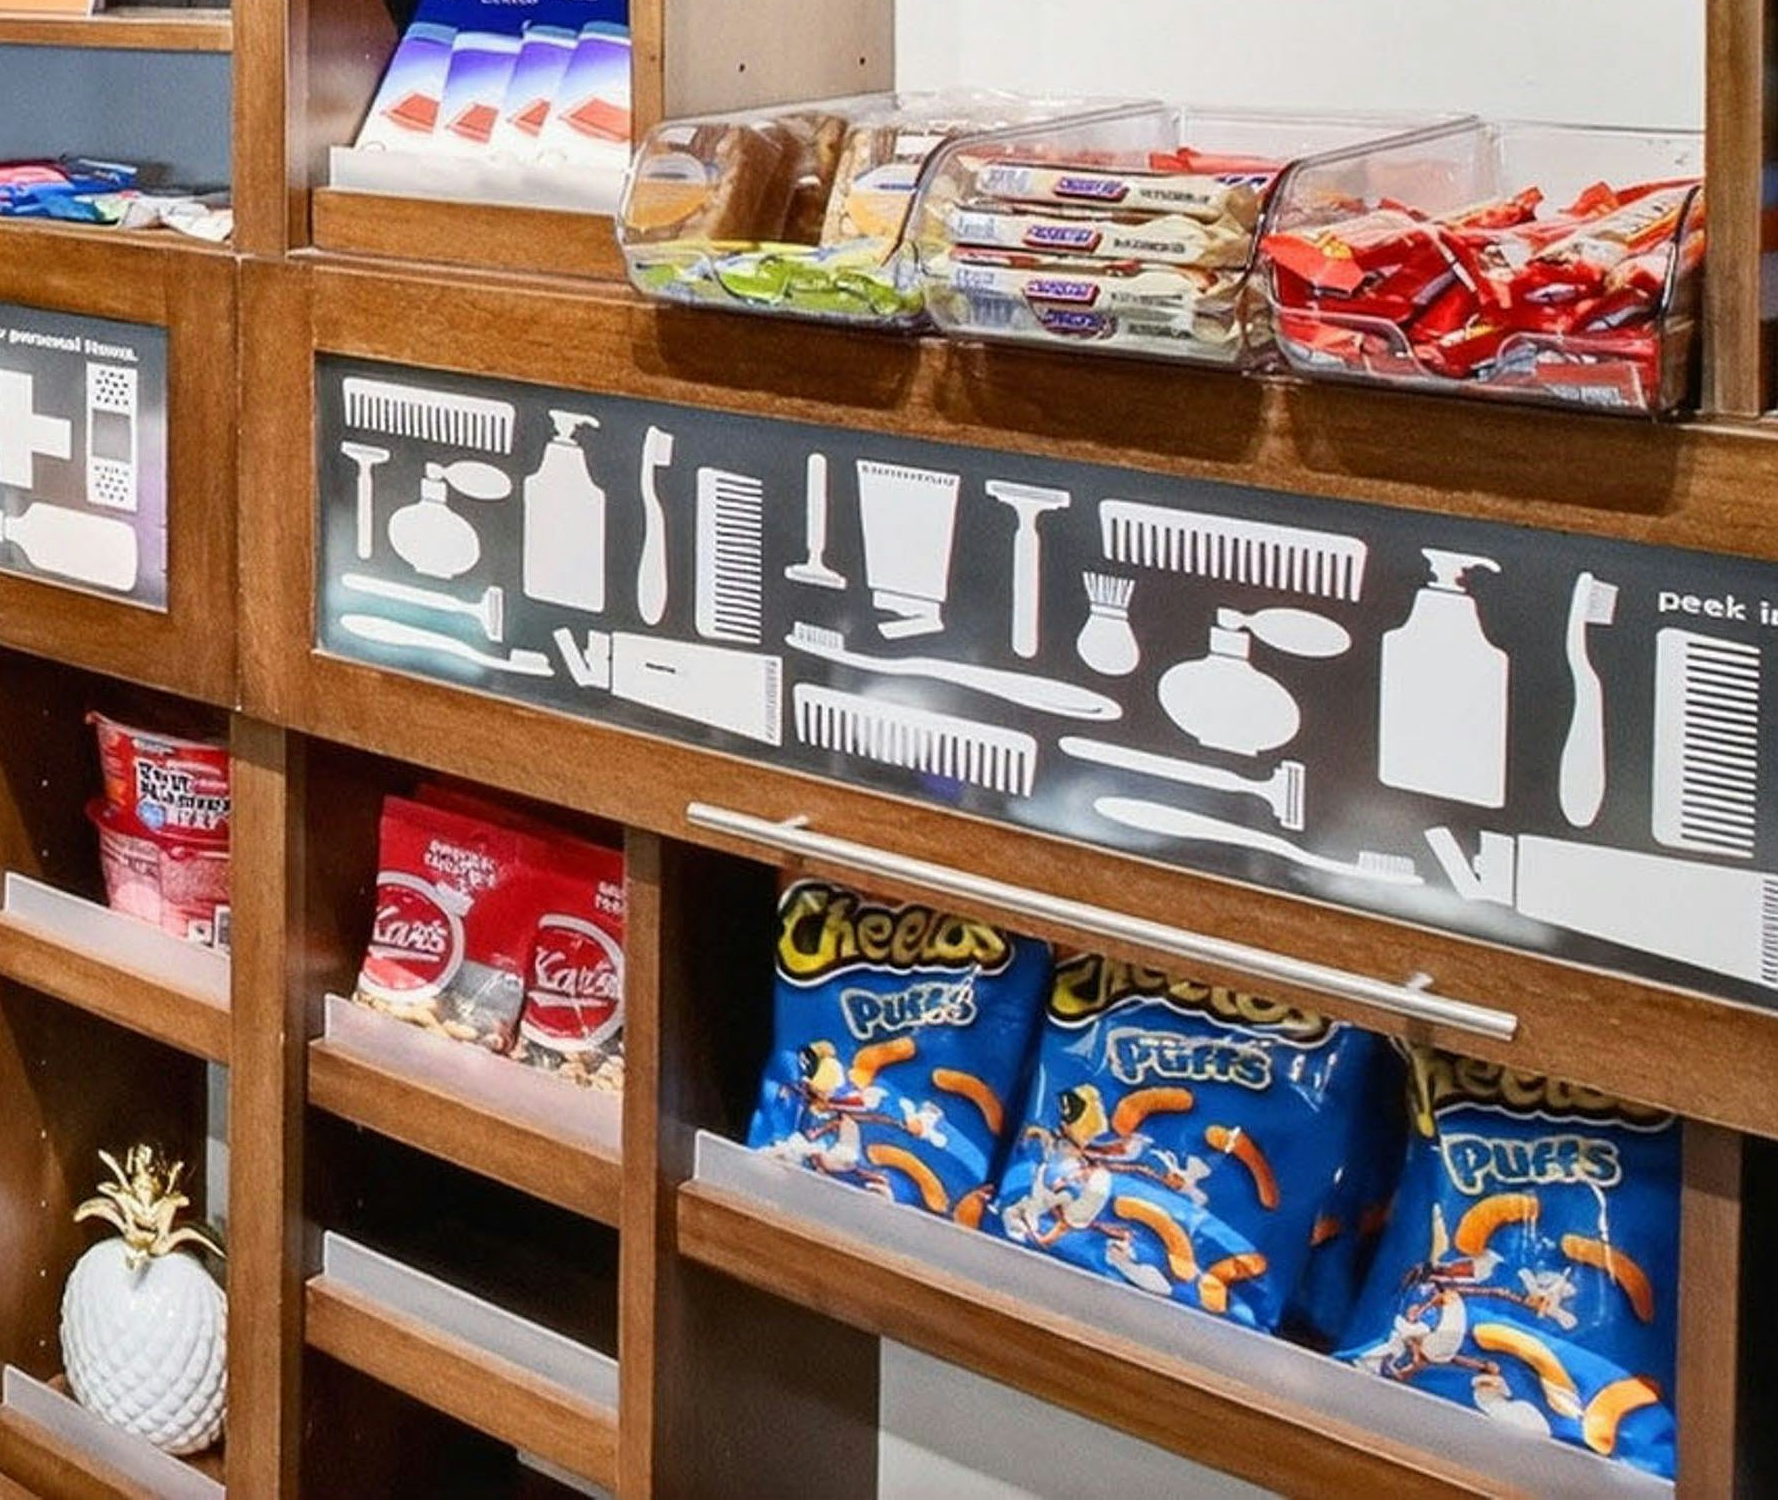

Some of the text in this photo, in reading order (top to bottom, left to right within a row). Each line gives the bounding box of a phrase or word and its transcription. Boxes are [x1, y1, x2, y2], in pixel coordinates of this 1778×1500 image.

[1658, 591, 1747, 622] peek
[780, 885, 1007, 978] Cheetos
[844, 987, 976, 1035] Puffs
[1108, 1030, 1270, 1090] Puffs
[1444, 1135, 1620, 1192] Puffs
